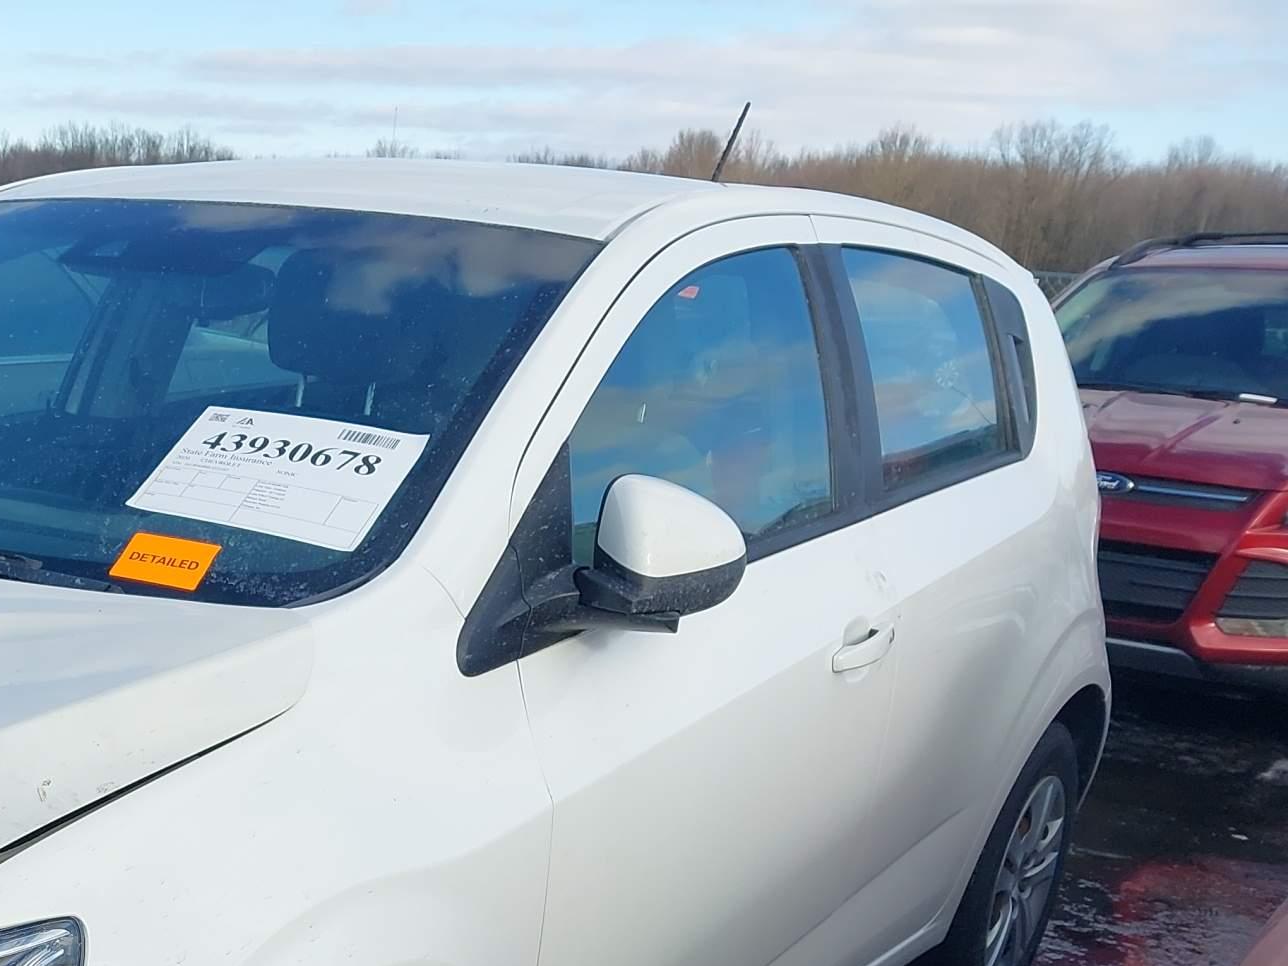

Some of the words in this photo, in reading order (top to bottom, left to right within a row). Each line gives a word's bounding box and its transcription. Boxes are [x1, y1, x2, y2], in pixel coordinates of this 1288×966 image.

[181, 447, 202, 456] State
[204, 451, 227, 460] Farm
[229, 454, 273, 466] Insurance
[202, 431, 383, 476] 43930678
[128, 551, 200, 571] DETAILED
